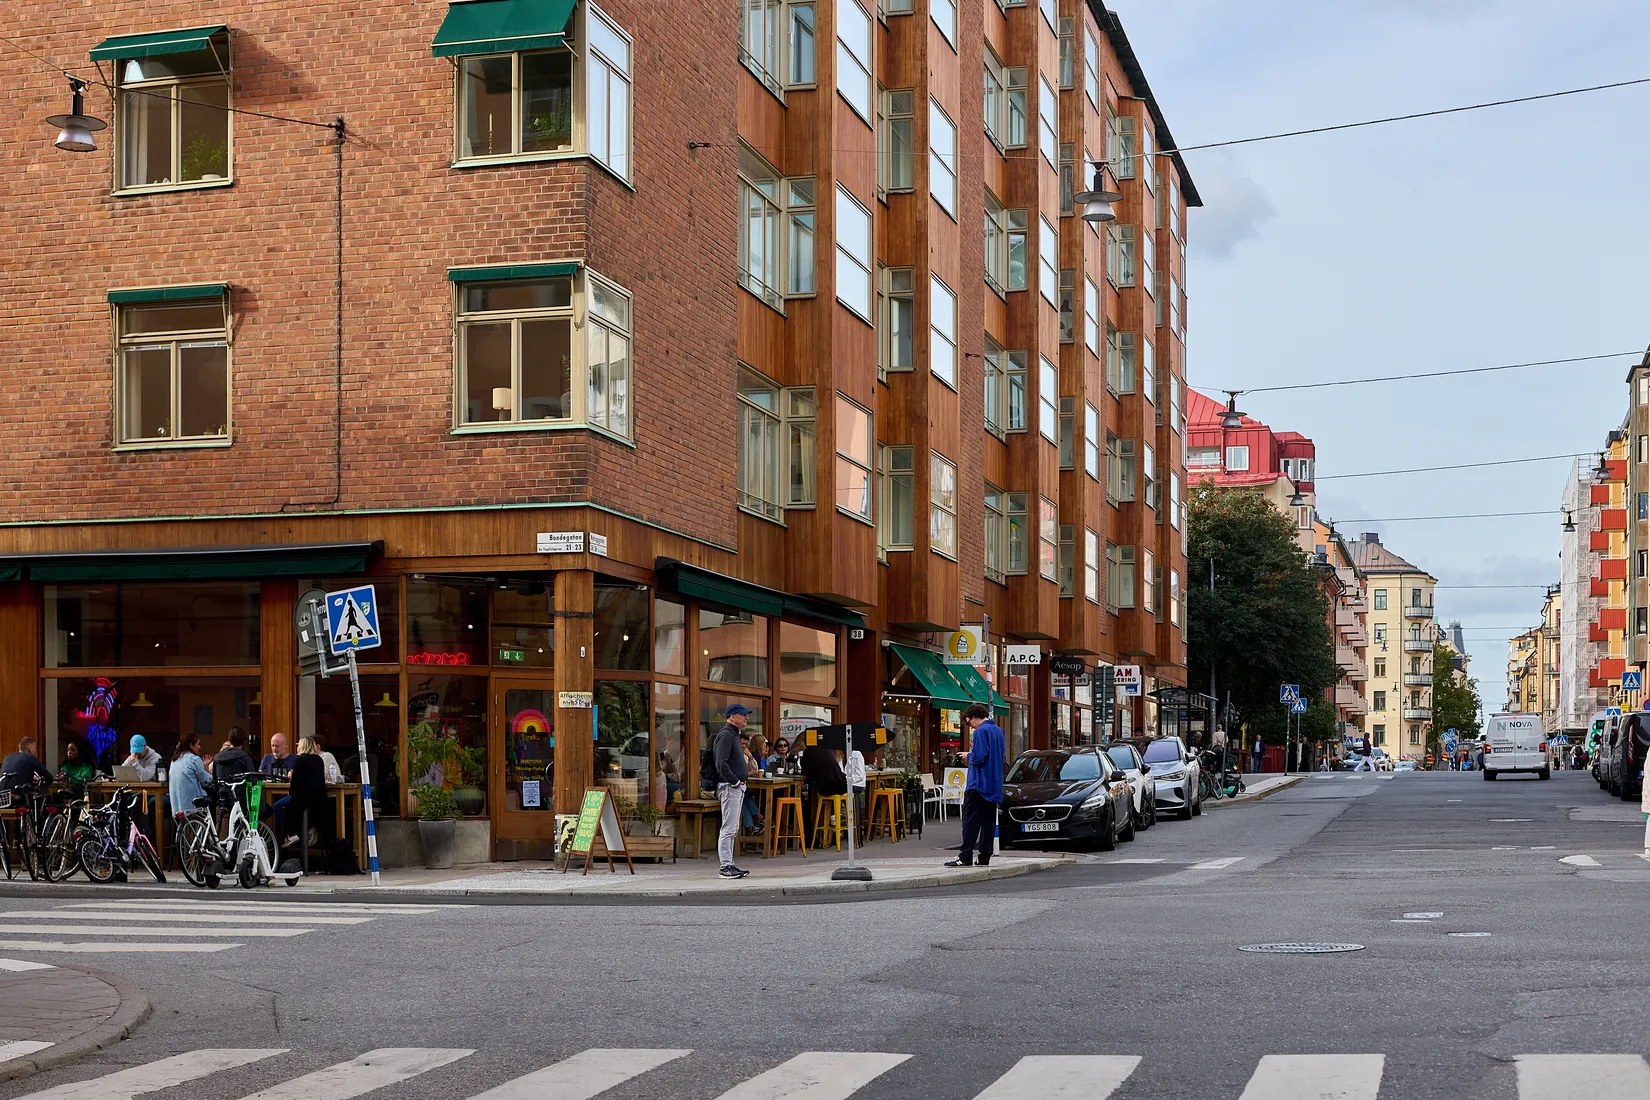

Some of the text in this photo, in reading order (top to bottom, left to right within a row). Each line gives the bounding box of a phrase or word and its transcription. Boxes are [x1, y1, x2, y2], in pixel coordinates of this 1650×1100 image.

[550, 534, 582, 542] Bondegatan
[853, 630, 861, 638] 38
[1009, 654, 1038, 663] A.P.C.
[1054, 661, 1082, 672] Aesop
[1115, 668, 1132, 677] AM
[1043, 823, 1057, 831] 808
